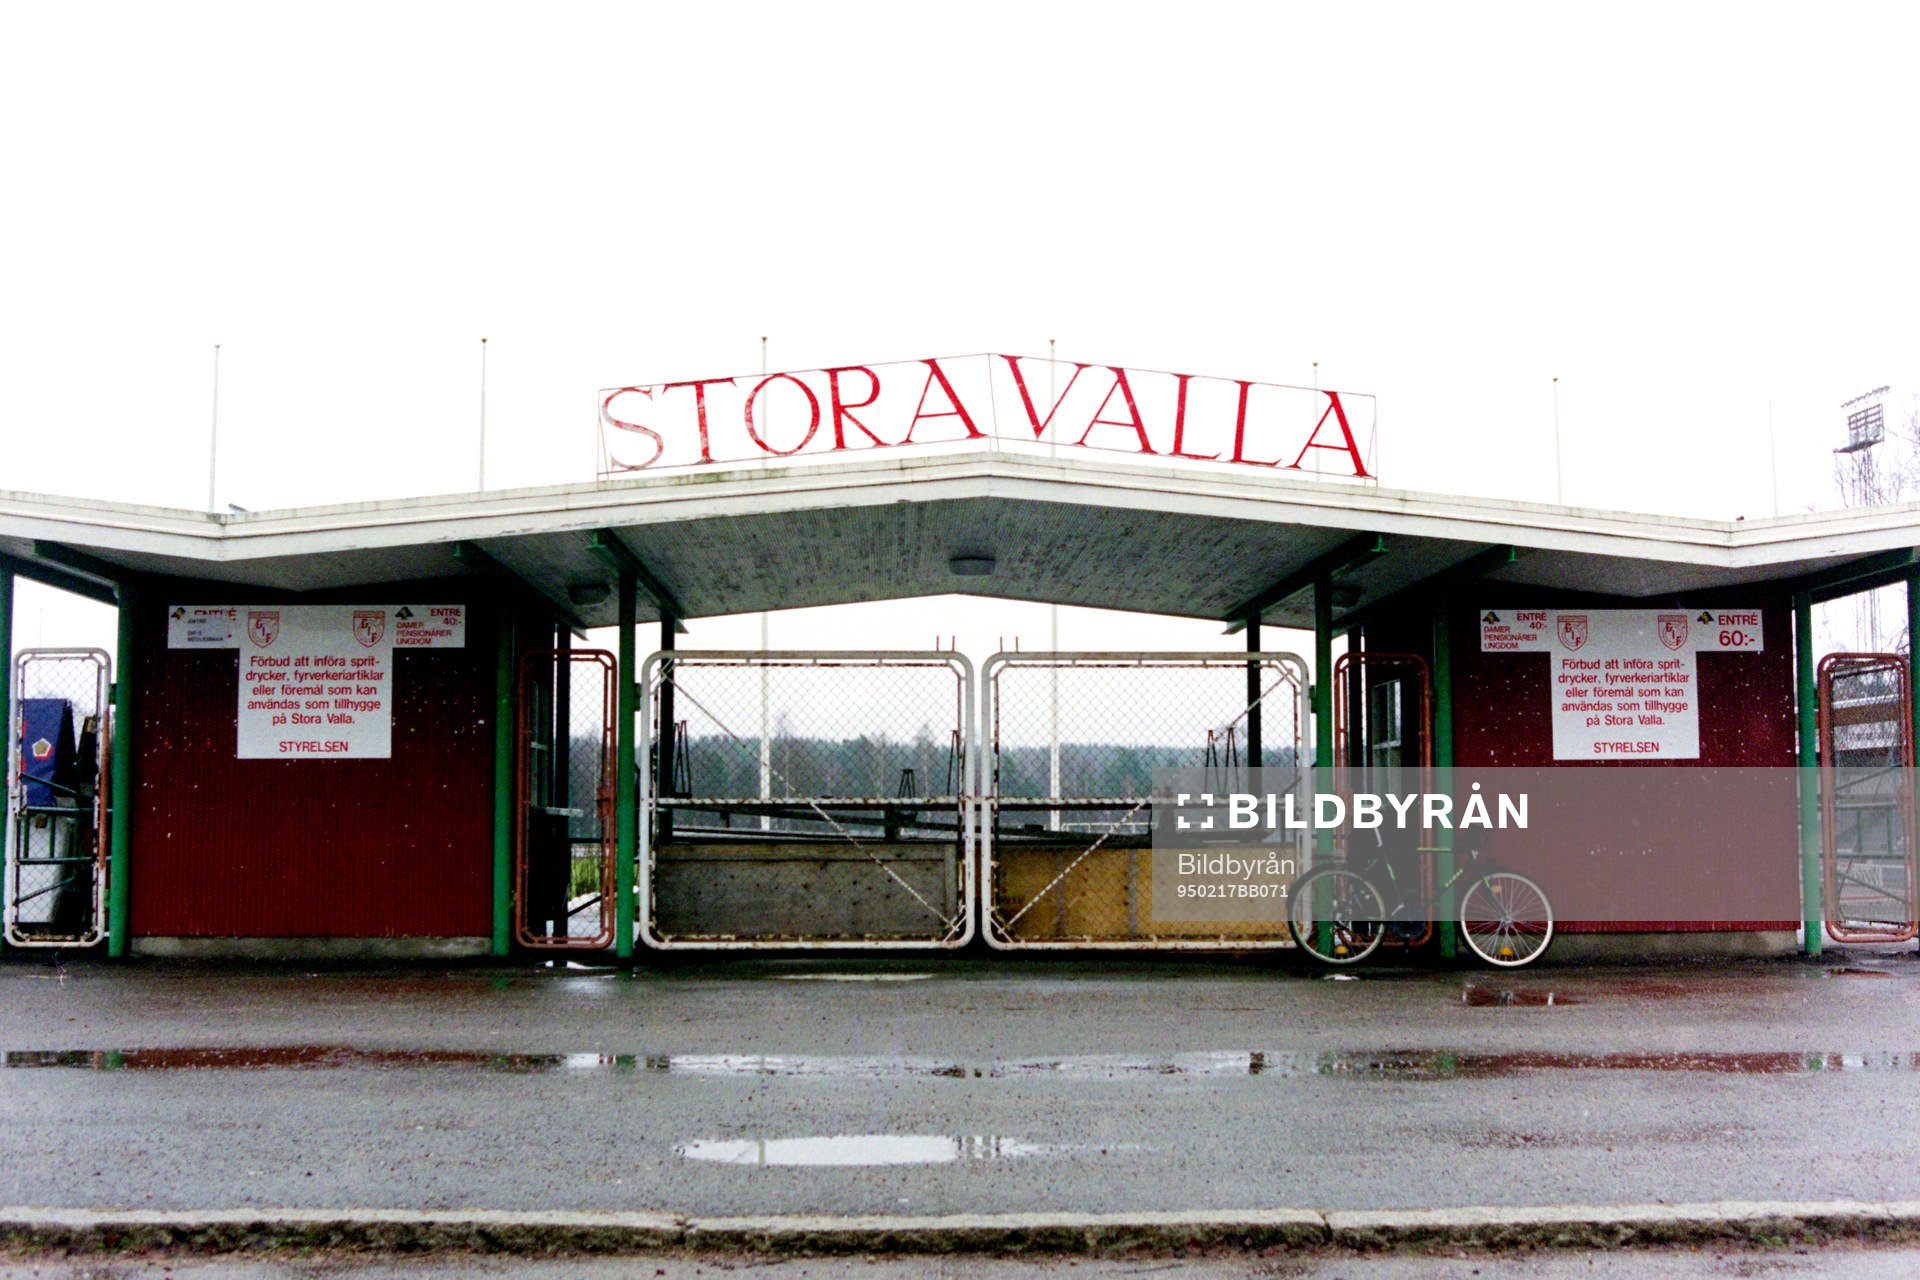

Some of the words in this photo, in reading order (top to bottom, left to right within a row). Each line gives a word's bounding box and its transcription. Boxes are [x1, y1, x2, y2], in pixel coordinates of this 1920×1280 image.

[602, 358, 989, 470] STORA
[999, 354, 1372, 478] VALLA
[1718, 612, 1758, 625] ENTRÉ
[1483, 625, 1511, 633] DAMER
[1719, 630, 1756, 647] 60:-
[250, 655, 291, 667] Förbud
[294, 656, 310, 667] att
[313, 655, 346, 667] införa
[350, 655, 381, 669] sprit-
[1561, 659, 1601, 670] Förbud
[1604, 659, 1619, 670] att
[1623, 659, 1654, 670] införa
[1657, 659, 1686, 672] sprit-
[245, 670, 291, 683] drycker,
[294, 670, 385, 683] fyrverkeriartiklar
[1558, 673, 1601, 685] drycker,
[1605, 672, 1690, 685] fyrverkeriartiklar
[252, 684, 277, 696] eller
[281, 684, 324, 696] föremål
[327, 686, 352, 696] som
[356, 685, 378, 696] kan
[1565, 687, 1589, 698] eller
[1593, 687, 1634, 698] föremål
[1637, 688, 1661, 697] som
[1664, 686, 1685, 697] kan
[247, 699, 301, 710] användas
[305, 701, 330, 710] som
[334, 699, 382, 712] tillhygge
[1561, 701, 1613, 712] användas
[1616, 702, 1641, 711] som
[1644, 700, 1689, 713] tillhygge
[272, 713, 288, 726] på
[291, 713, 322, 725] Stora
[327, 713, 356, 725] Valla.
[1586, 715, 1601, 728] på
[1604, 714, 1634, 726] Stora
[1638, 714, 1665, 725] Valla.
[279, 741, 349, 753] STYRELSEN
[1593, 741, 1660, 754] STYRELSEN
